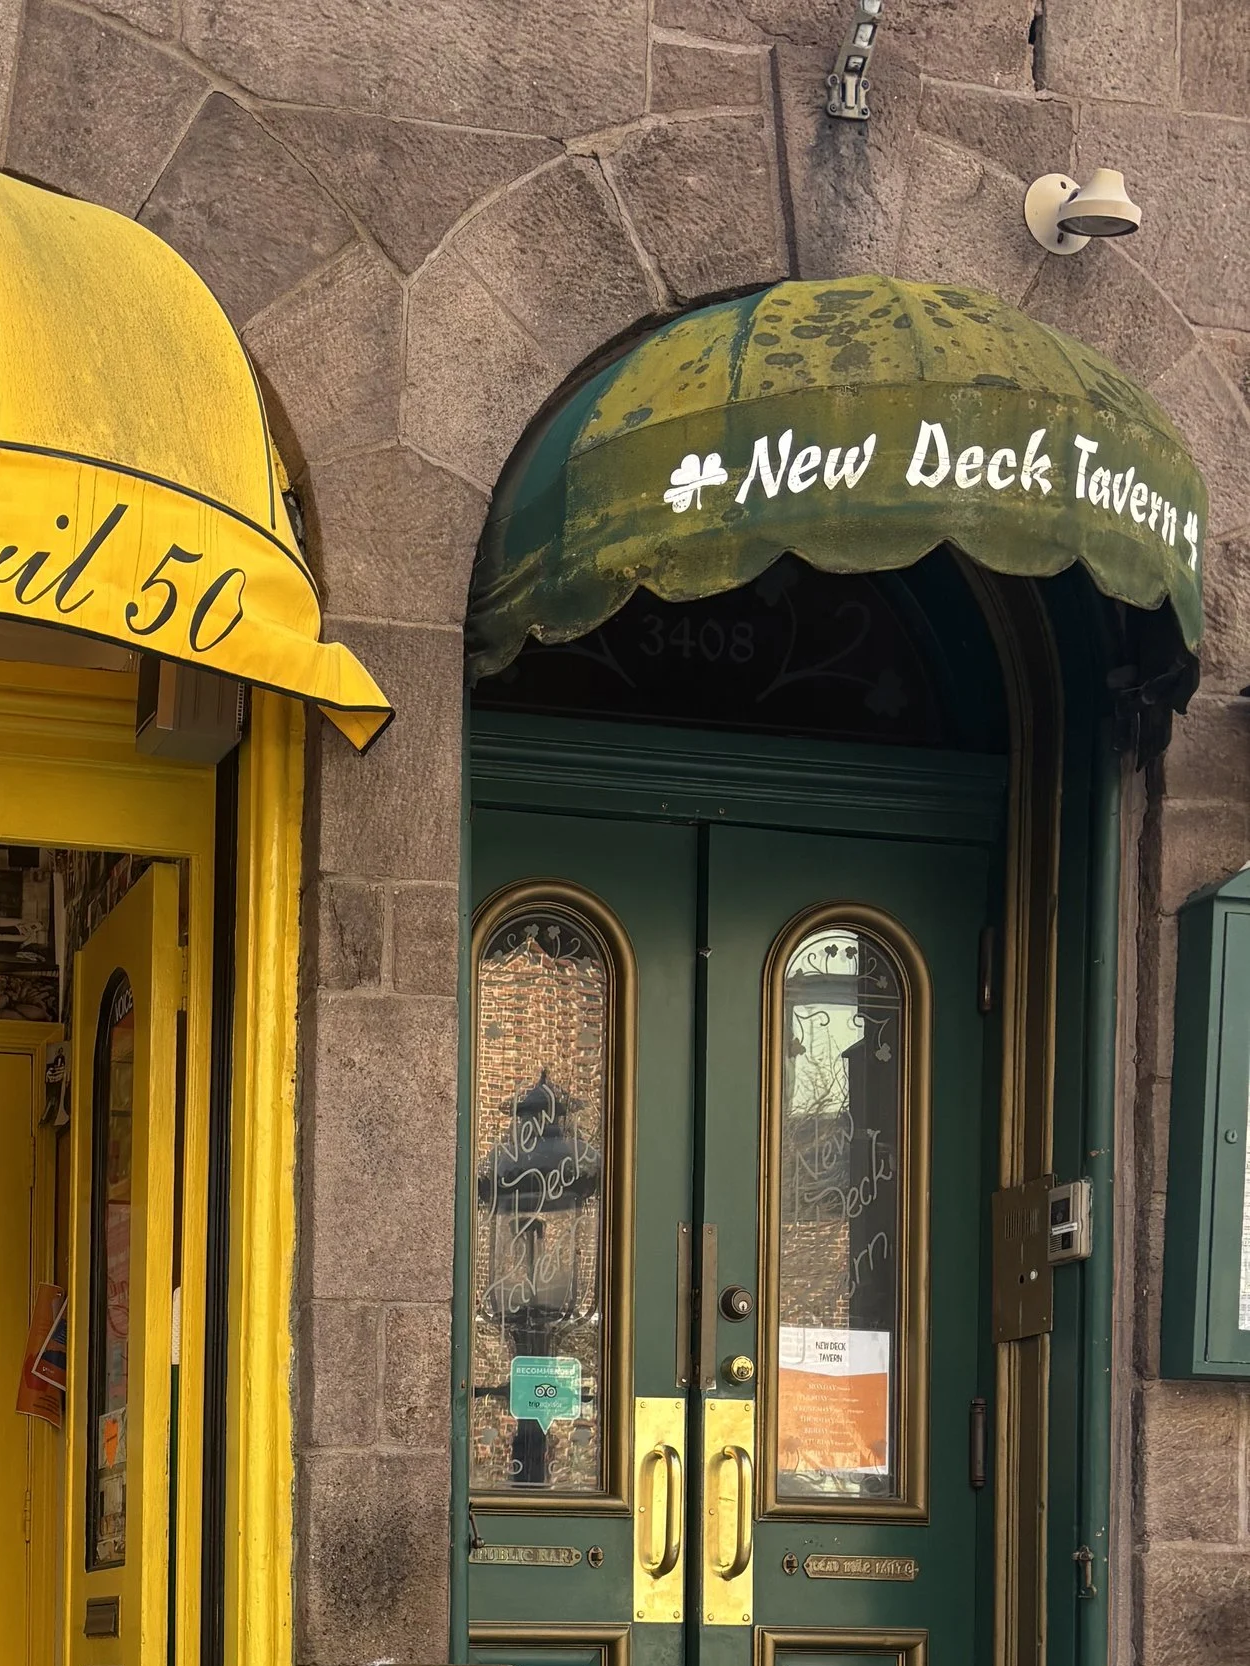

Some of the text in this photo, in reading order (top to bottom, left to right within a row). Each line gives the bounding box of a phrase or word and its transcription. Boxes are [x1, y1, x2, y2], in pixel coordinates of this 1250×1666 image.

[734, 419, 1176, 546] New Deck Tavern
[125, 543, 249, 652] 50
[639, 614, 755, 664] 3408
[487, 1079, 556, 1223] New
[500, 1117, 601, 1256] Deck
[819, 1353, 843, 1363] TAVERN
